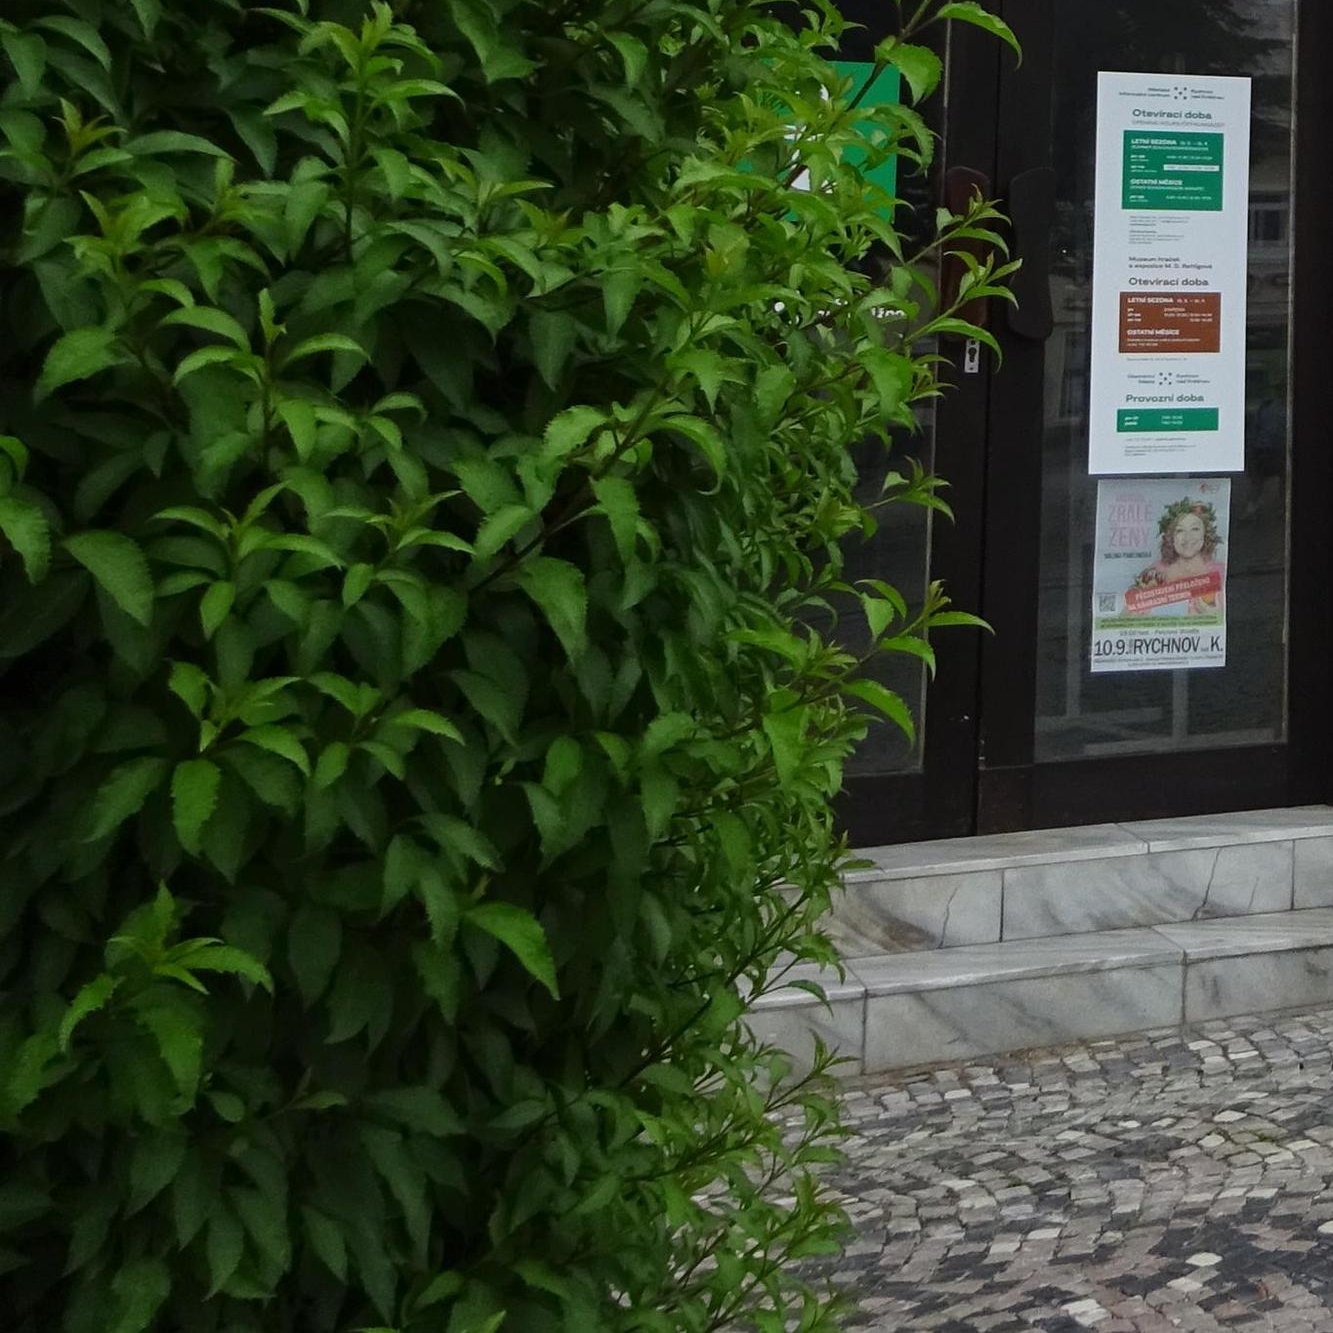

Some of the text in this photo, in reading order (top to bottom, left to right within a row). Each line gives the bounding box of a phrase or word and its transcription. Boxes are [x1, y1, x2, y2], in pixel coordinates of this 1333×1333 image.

[1132, 108, 1212, 120] Otevírací doba
[1128, 277, 1209, 286] Otevírací doba
[1126, 394, 1204, 402] Provozní doba
[1094, 639, 1130, 657] 10.9.
[1133, 635, 1200, 655] RYCHNOV
[1210, 635, 1224, 653] K.
